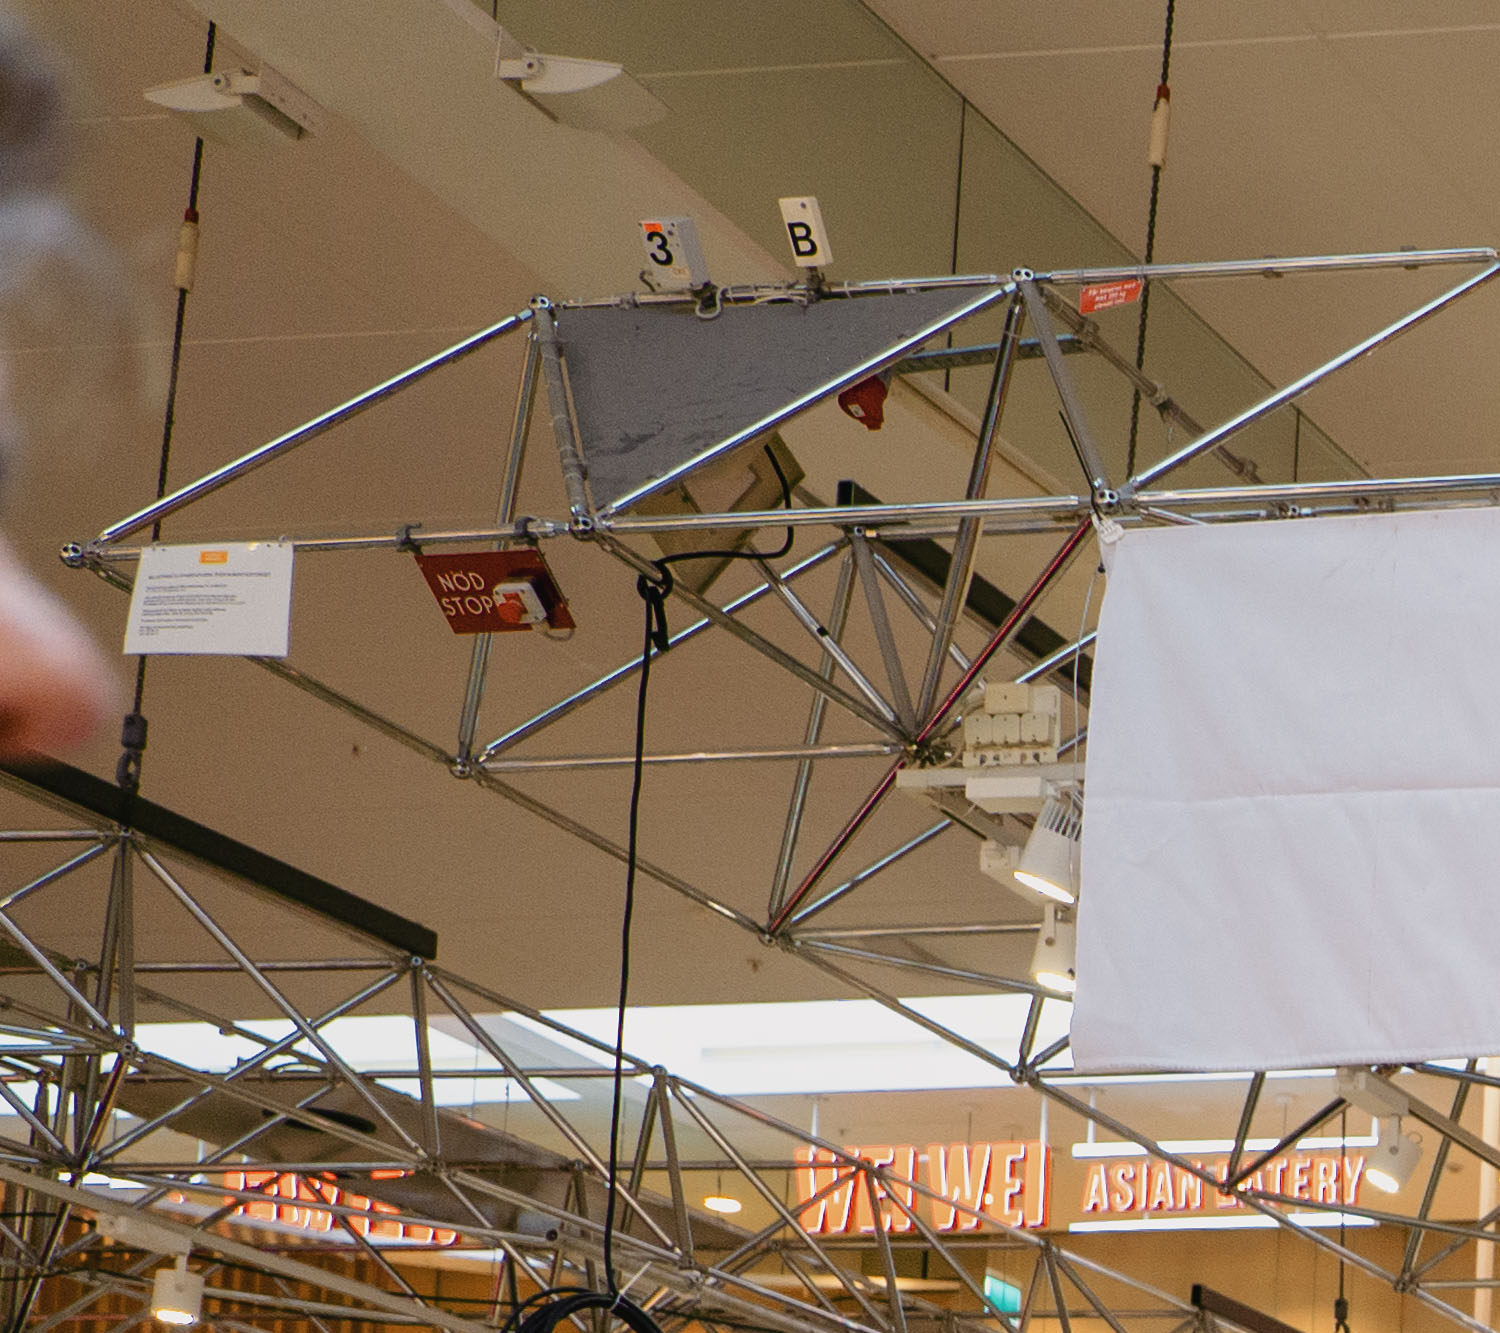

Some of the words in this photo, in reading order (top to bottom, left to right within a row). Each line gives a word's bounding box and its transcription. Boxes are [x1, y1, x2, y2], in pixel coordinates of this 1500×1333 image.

[647, 231, 673, 266] 3
[787, 221, 818, 257] B
[437, 570, 485, 592] NÖD
[1083, 1159, 1206, 1213] ASIAN
